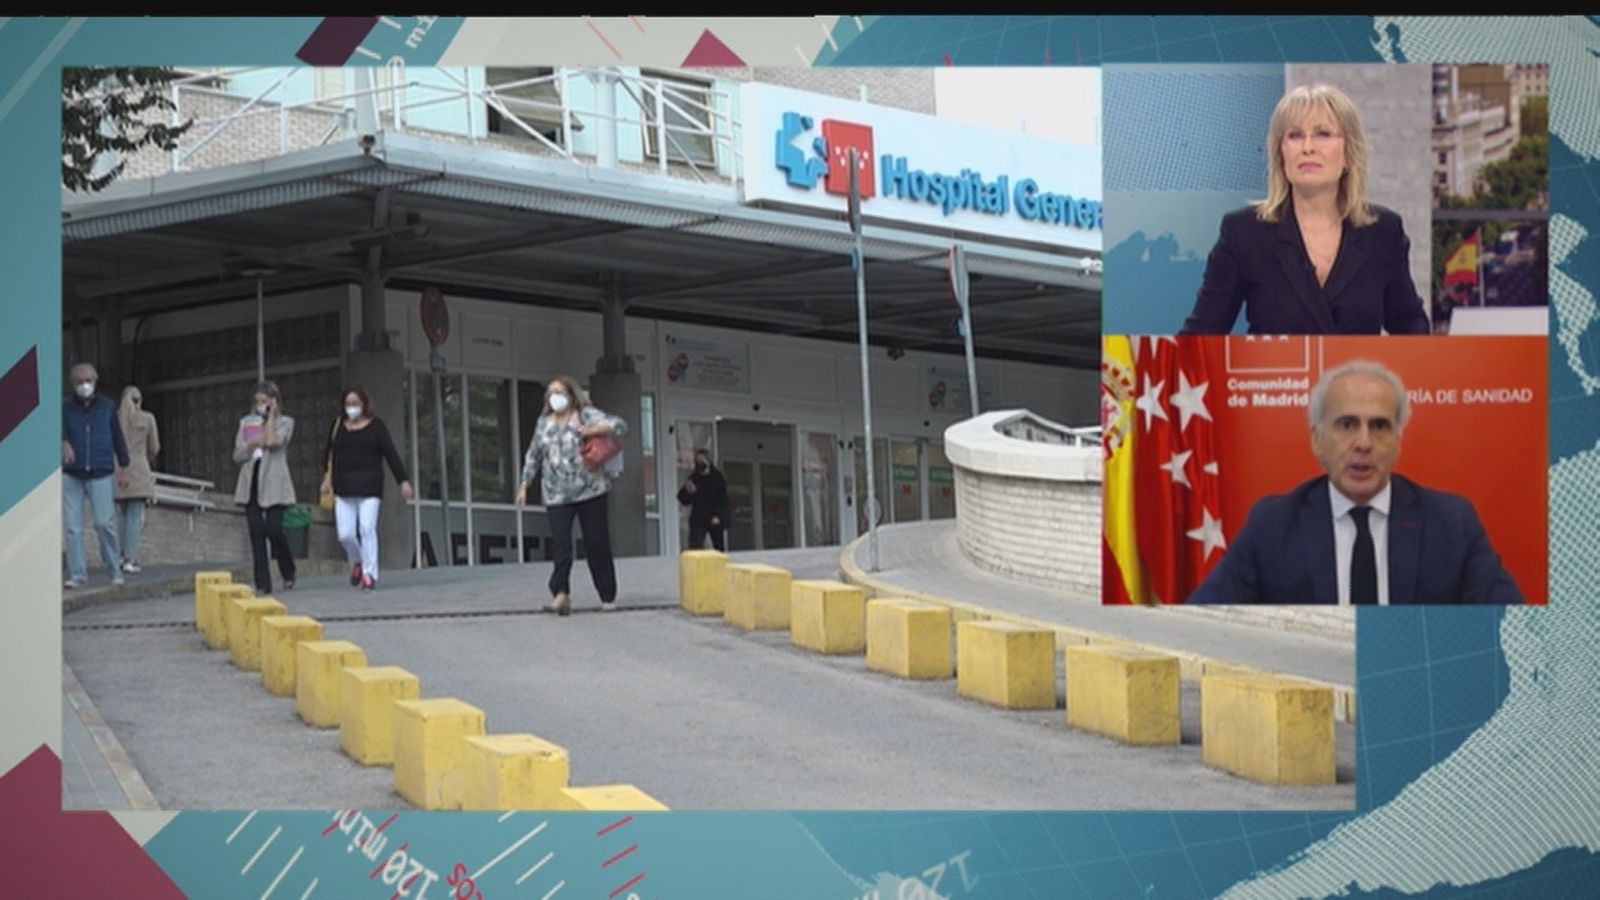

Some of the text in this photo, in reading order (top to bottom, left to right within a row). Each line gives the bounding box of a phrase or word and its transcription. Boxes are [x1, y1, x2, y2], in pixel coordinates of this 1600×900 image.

[881, 154, 1009, 216] Hospital
[1227, 377, 1309, 391] Comunidad
[1227, 393, 1309, 408] de Madrid
[1407, 386, 1533, 404] RÍA DE SANIDAD
